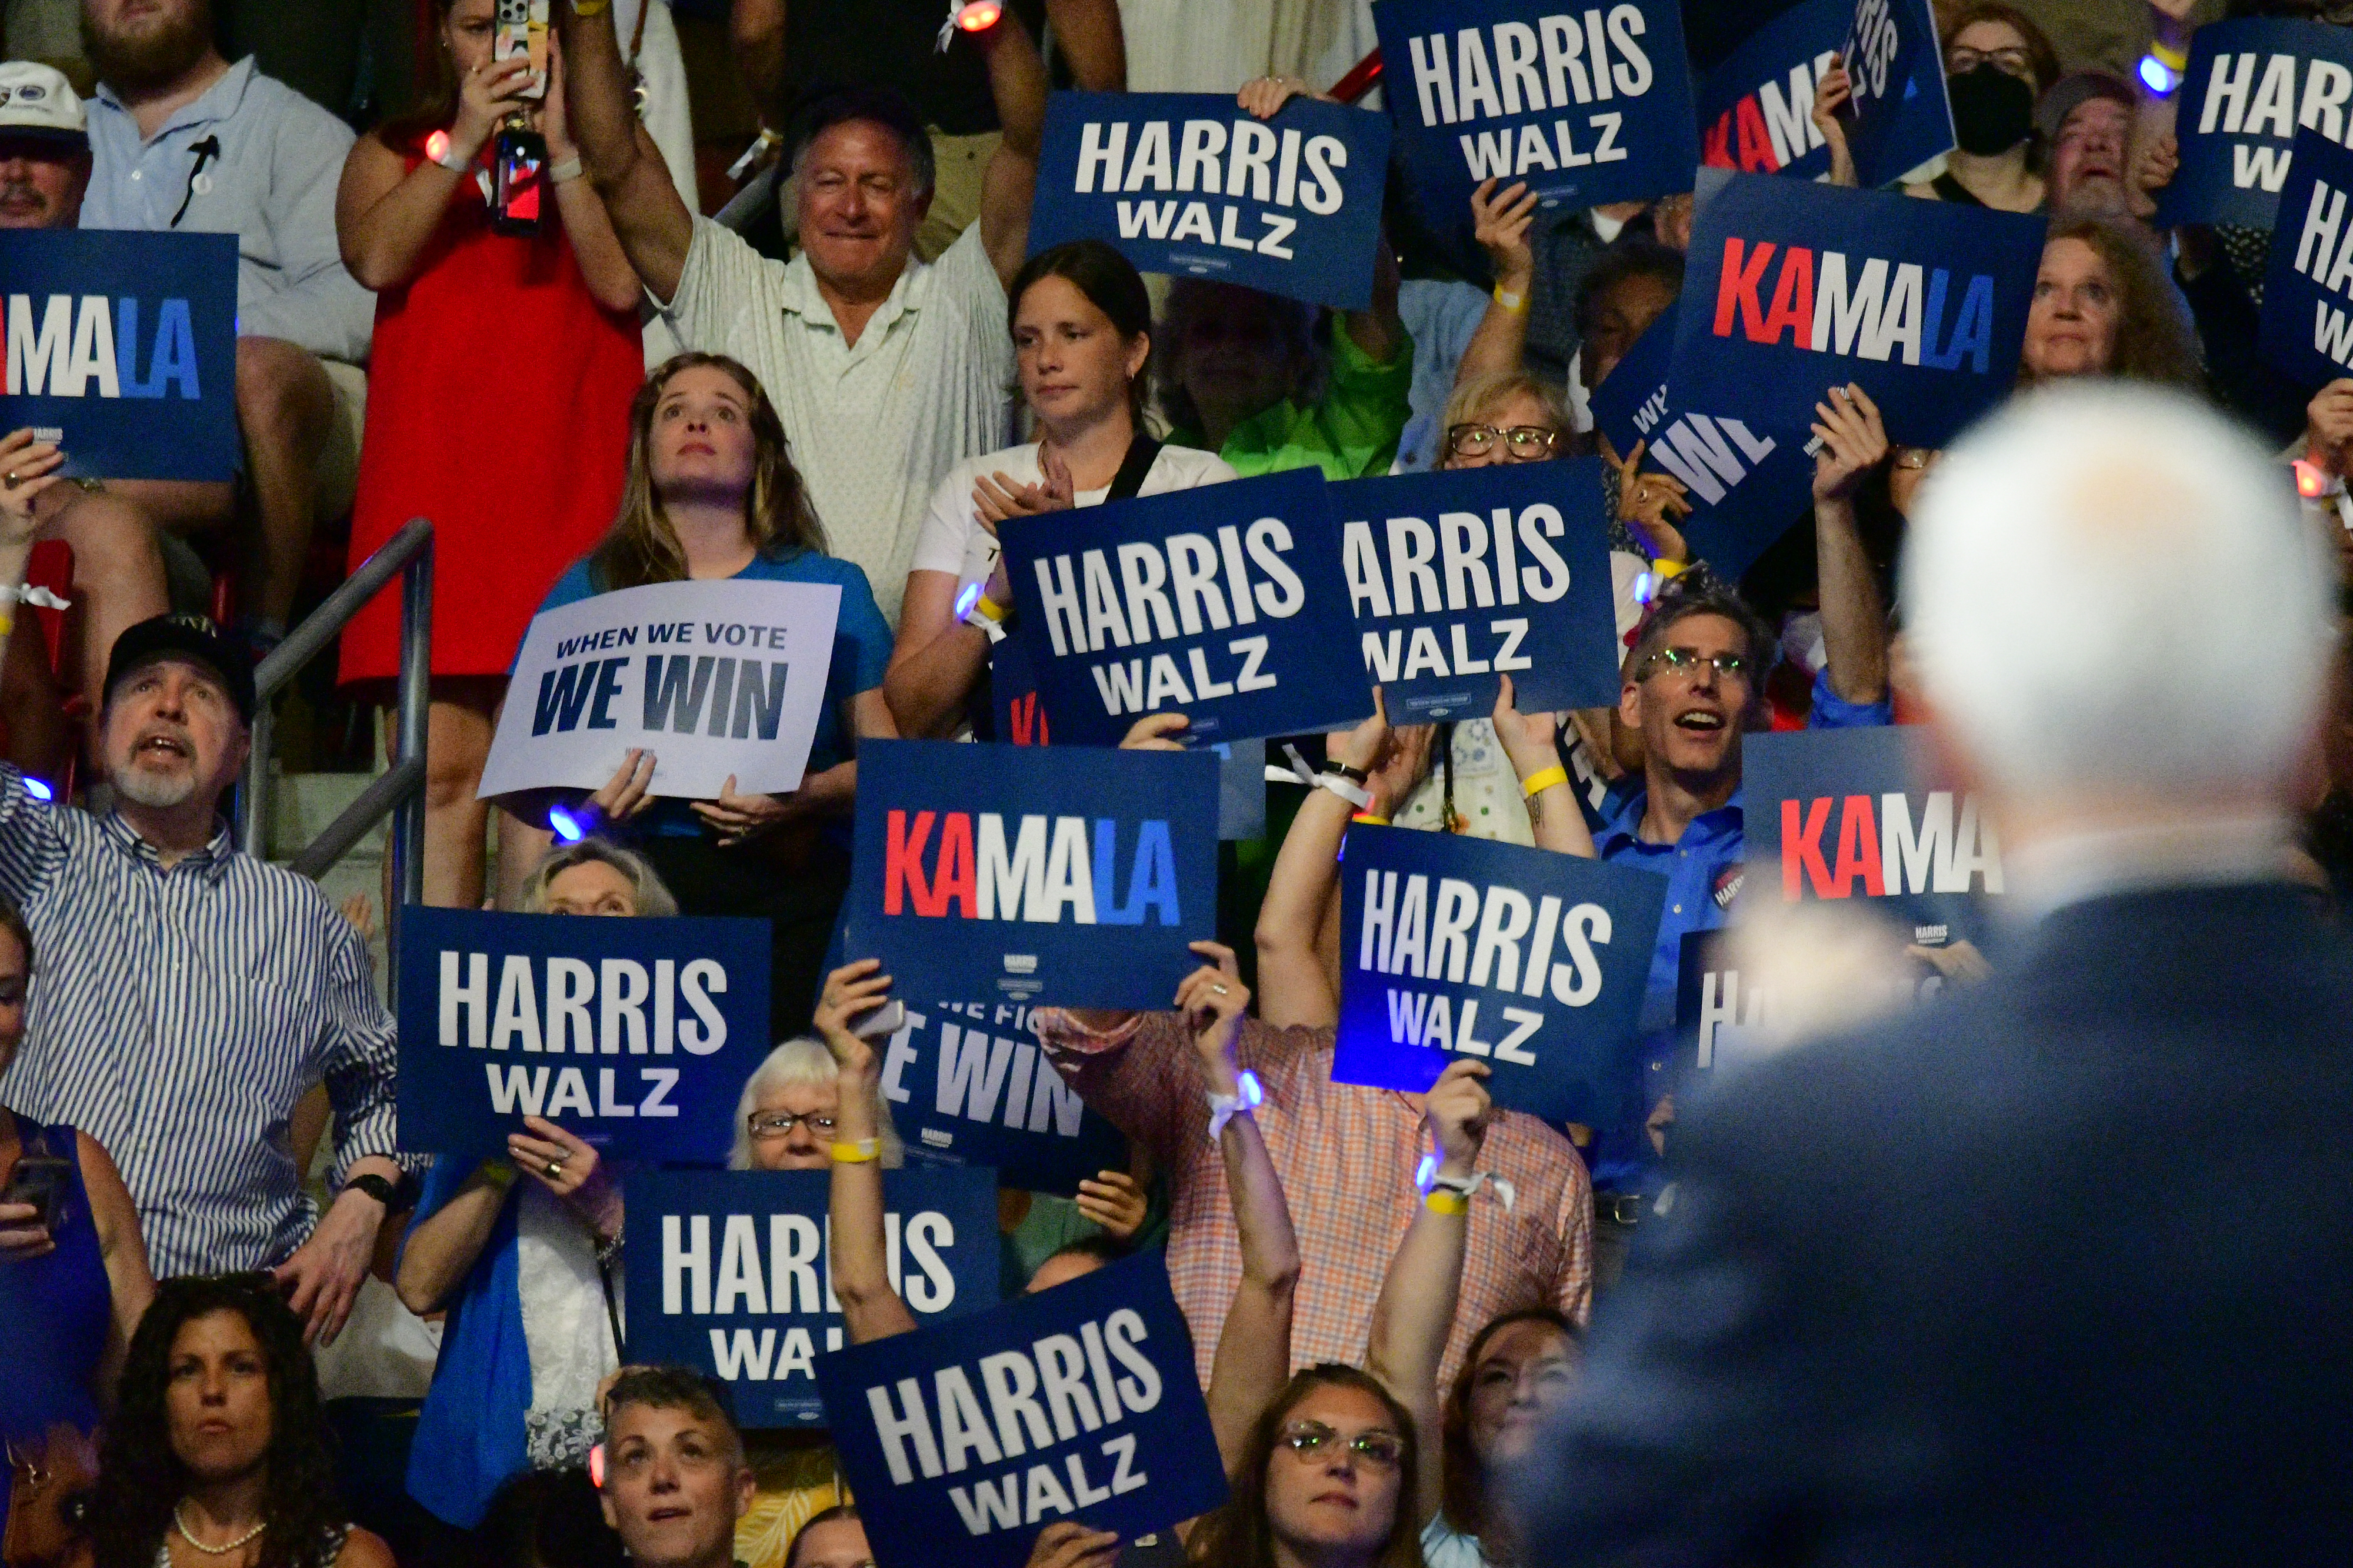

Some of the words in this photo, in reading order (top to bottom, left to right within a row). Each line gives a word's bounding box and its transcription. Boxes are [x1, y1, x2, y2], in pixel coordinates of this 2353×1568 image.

[1409, 4, 1652, 126] HARRIS
[2198, 53, 2353, 151] HAR
[1075, 119, 1347, 215] HARRIS
[1459, 112, 1627, 181] WALZ
[1116, 200, 1297, 259] WALZ
[0, 294, 201, 399] MALA
[1713, 237, 1994, 375] KAMALA
[1034, 517, 1305, 658] HARRIS
[1342, 503, 1570, 619] ARRIS
[556, 625, 639, 659] WHEN
[648, 622, 695, 644] WE
[705, 623, 787, 649] VOTE
[1091, 635, 1277, 716] WALZ
[531, 656, 629, 738] WE
[642, 654, 789, 740] WIN
[884, 809, 1181, 927] KAMALA
[1781, 790, 2003, 902] KAMA
[1359, 869, 1612, 1007] HARRIS
[1915, 925, 1947, 939] HARRIS
[439, 950, 727, 1056] HARRIS
[1387, 989, 1544, 1066] WALZ
[486, 1063, 679, 1117] WALZ
[883, 1010, 926, 1104] E
[936, 1022, 1084, 1137] WIN
[866, 1308, 1162, 1486] HARRIS
[948, 1433, 1148, 1536] WALZ
